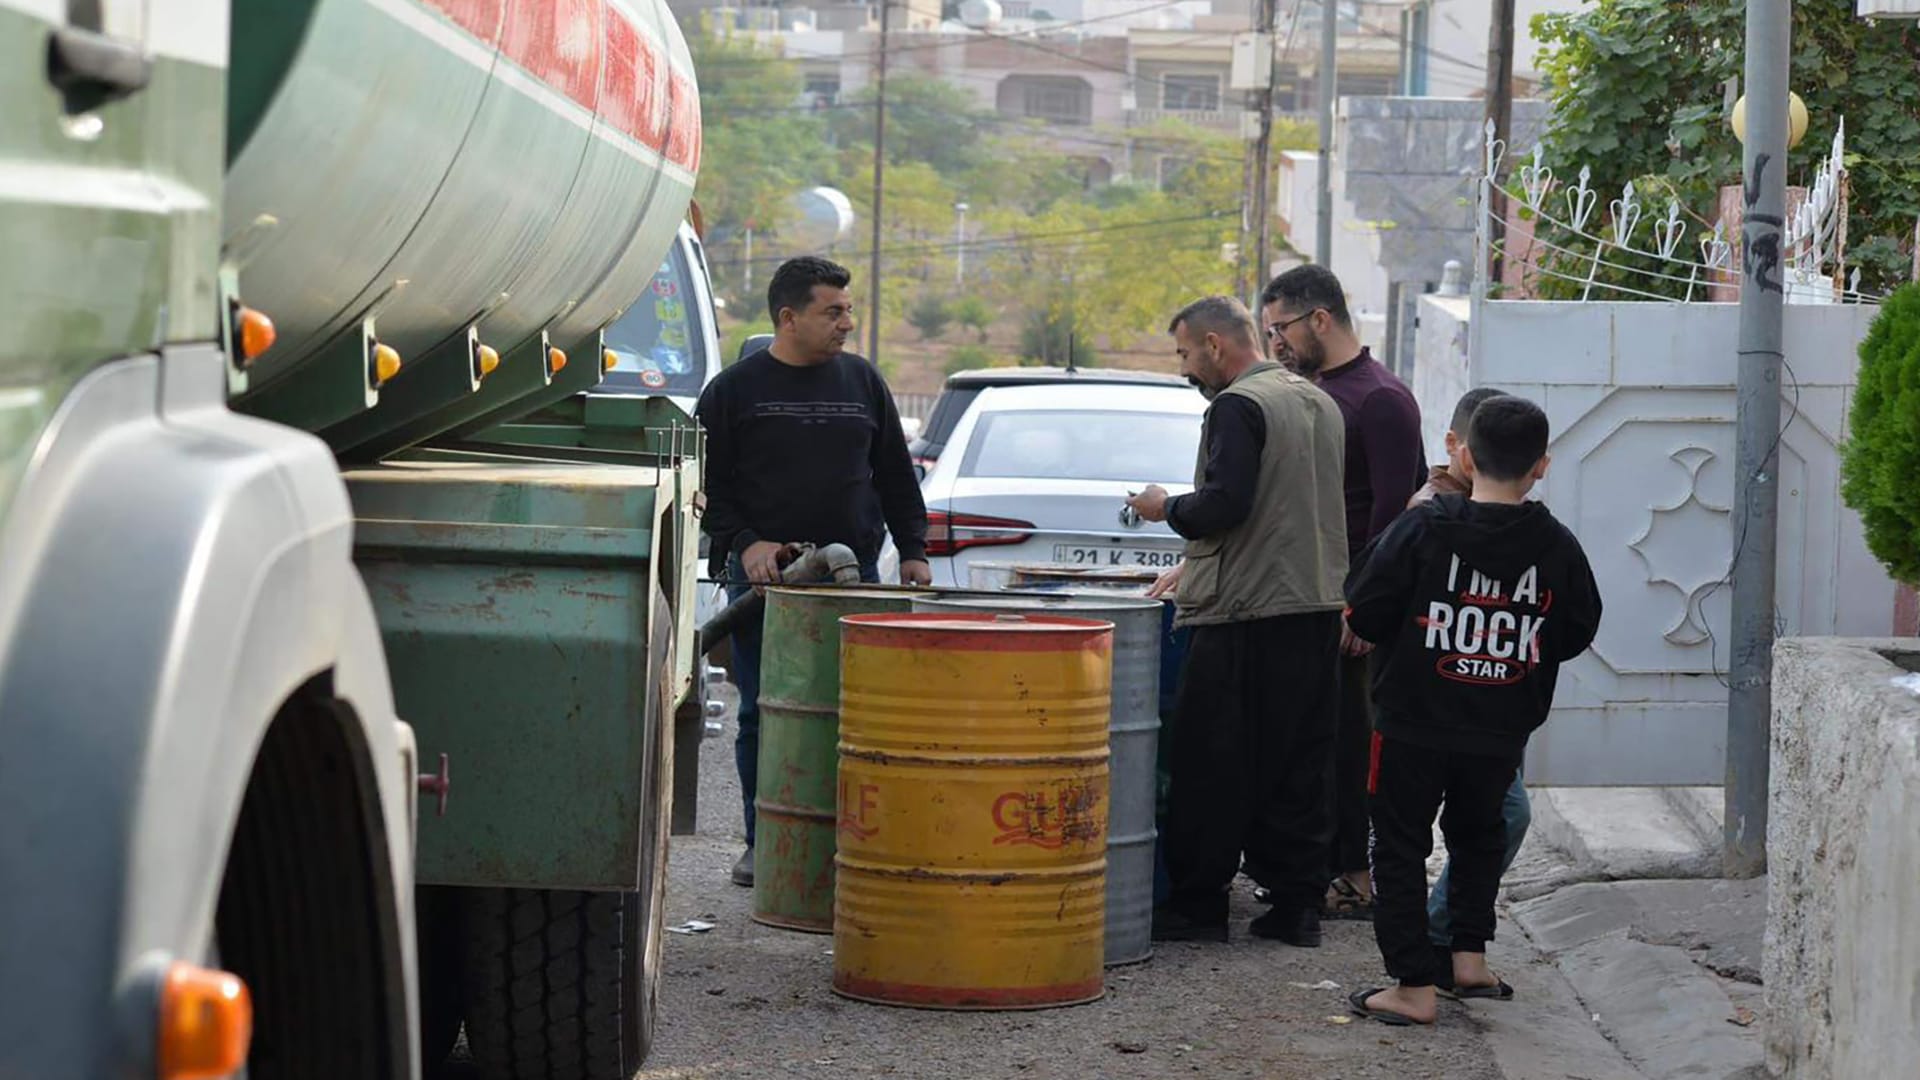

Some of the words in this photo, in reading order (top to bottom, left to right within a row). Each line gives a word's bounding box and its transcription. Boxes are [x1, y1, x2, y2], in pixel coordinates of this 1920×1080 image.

[1073, 549, 1098, 564] 21
[1110, 550, 1123, 565] K
[1512, 565, 1537, 604] A
[1425, 601, 1545, 663] ROCK
[1456, 658, 1508, 680] STAR
